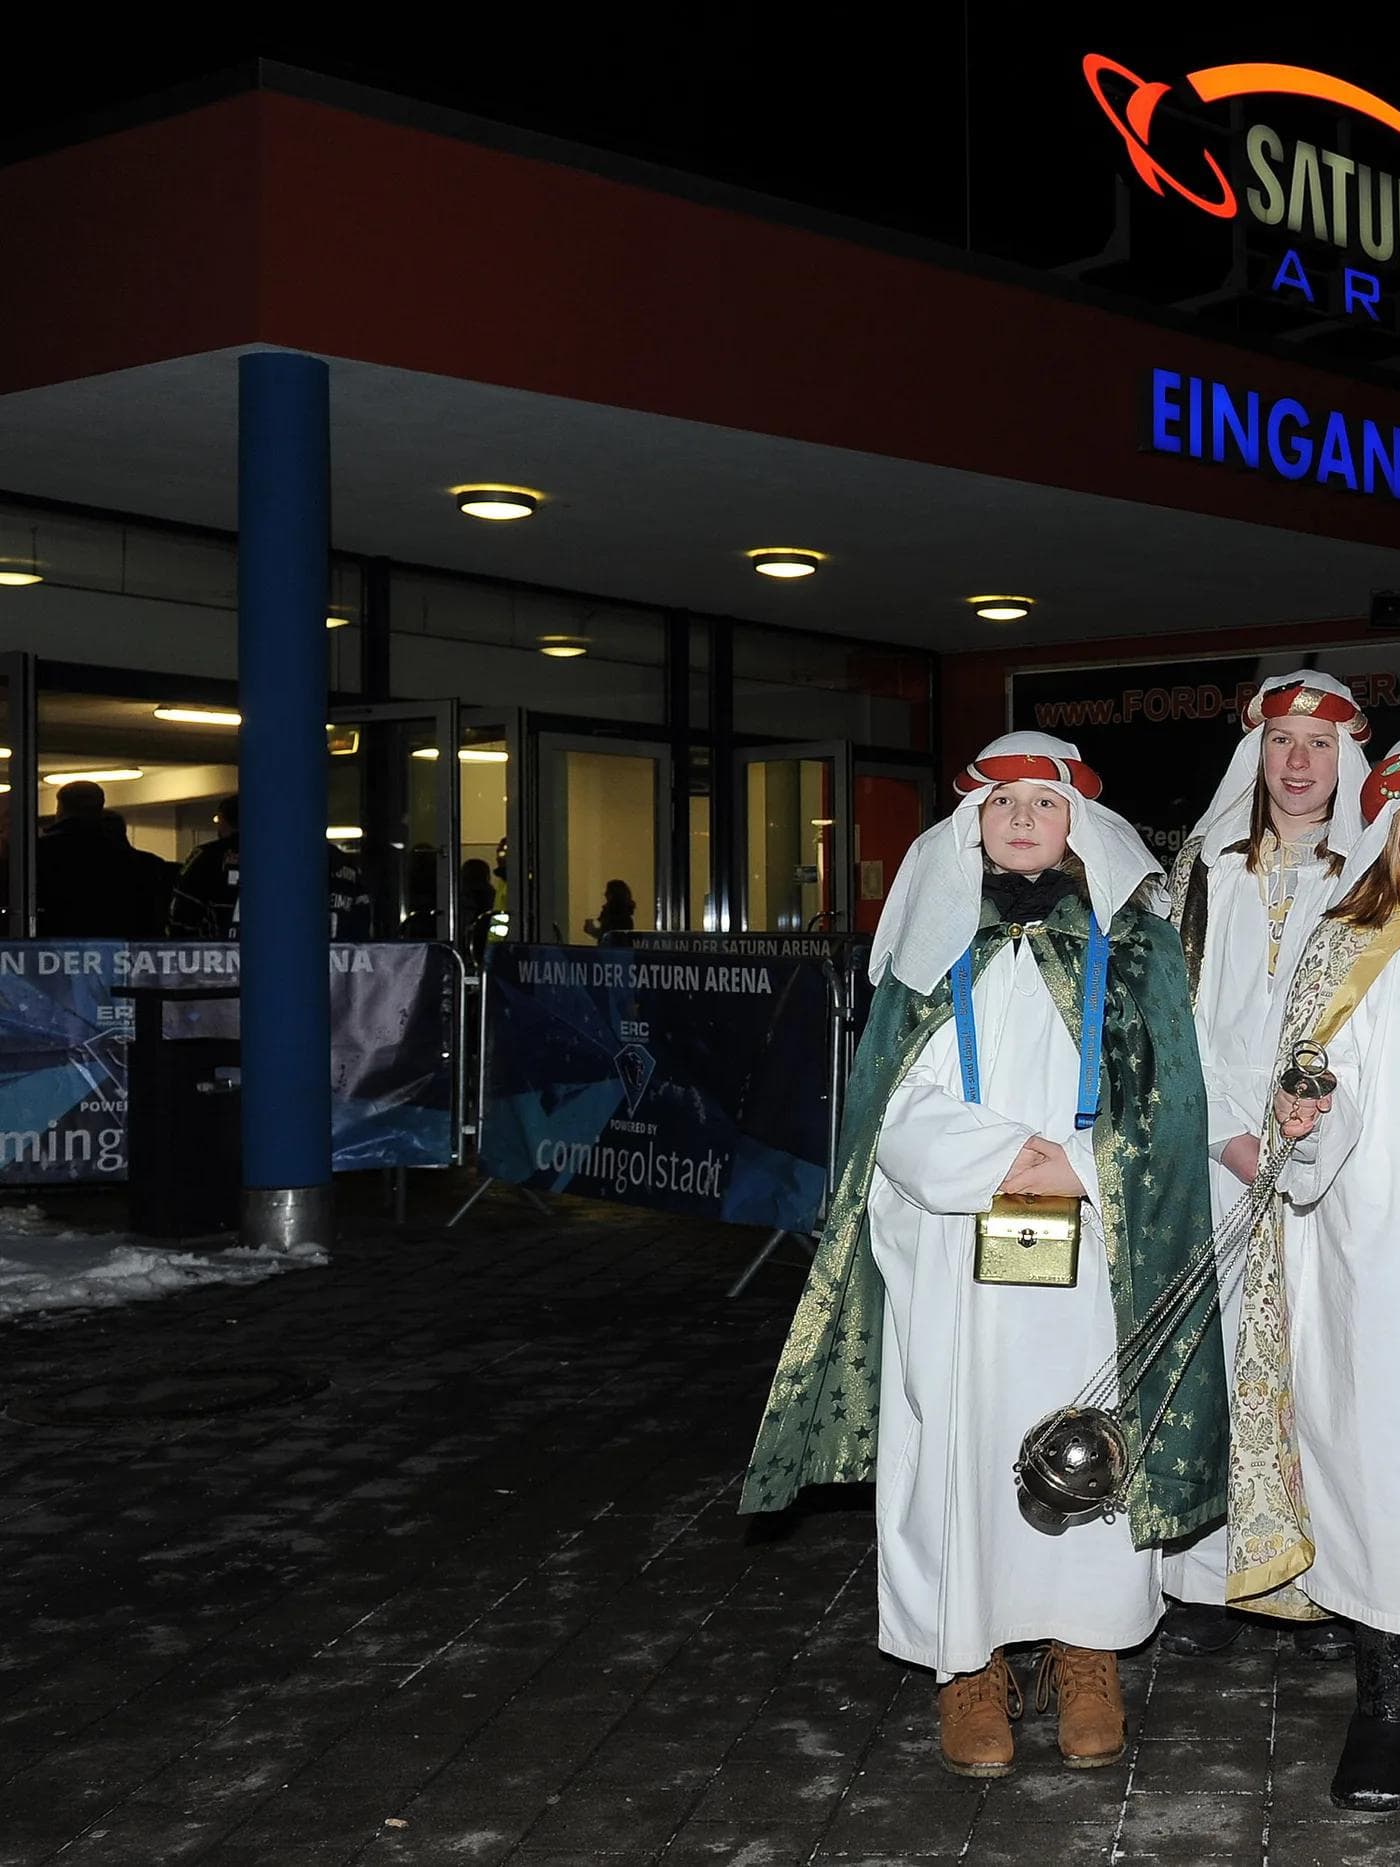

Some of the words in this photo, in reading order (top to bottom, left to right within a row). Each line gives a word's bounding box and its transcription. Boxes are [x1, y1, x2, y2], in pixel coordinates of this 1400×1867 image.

[722, 940, 777, 955] SATURN
[781, 940, 832, 957] ARENA
[38, 951, 103, 975] DER
[518, 960, 567, 985] WLAN
[571, 963, 588, 986] IN
[593, 964, 624, 988] DER
[628, 964, 700, 991] SATURN
[704, 966, 772, 994] ARENA
[620, 1021, 650, 1036] ERC
[536, 1135, 723, 1198] comingolstadt
